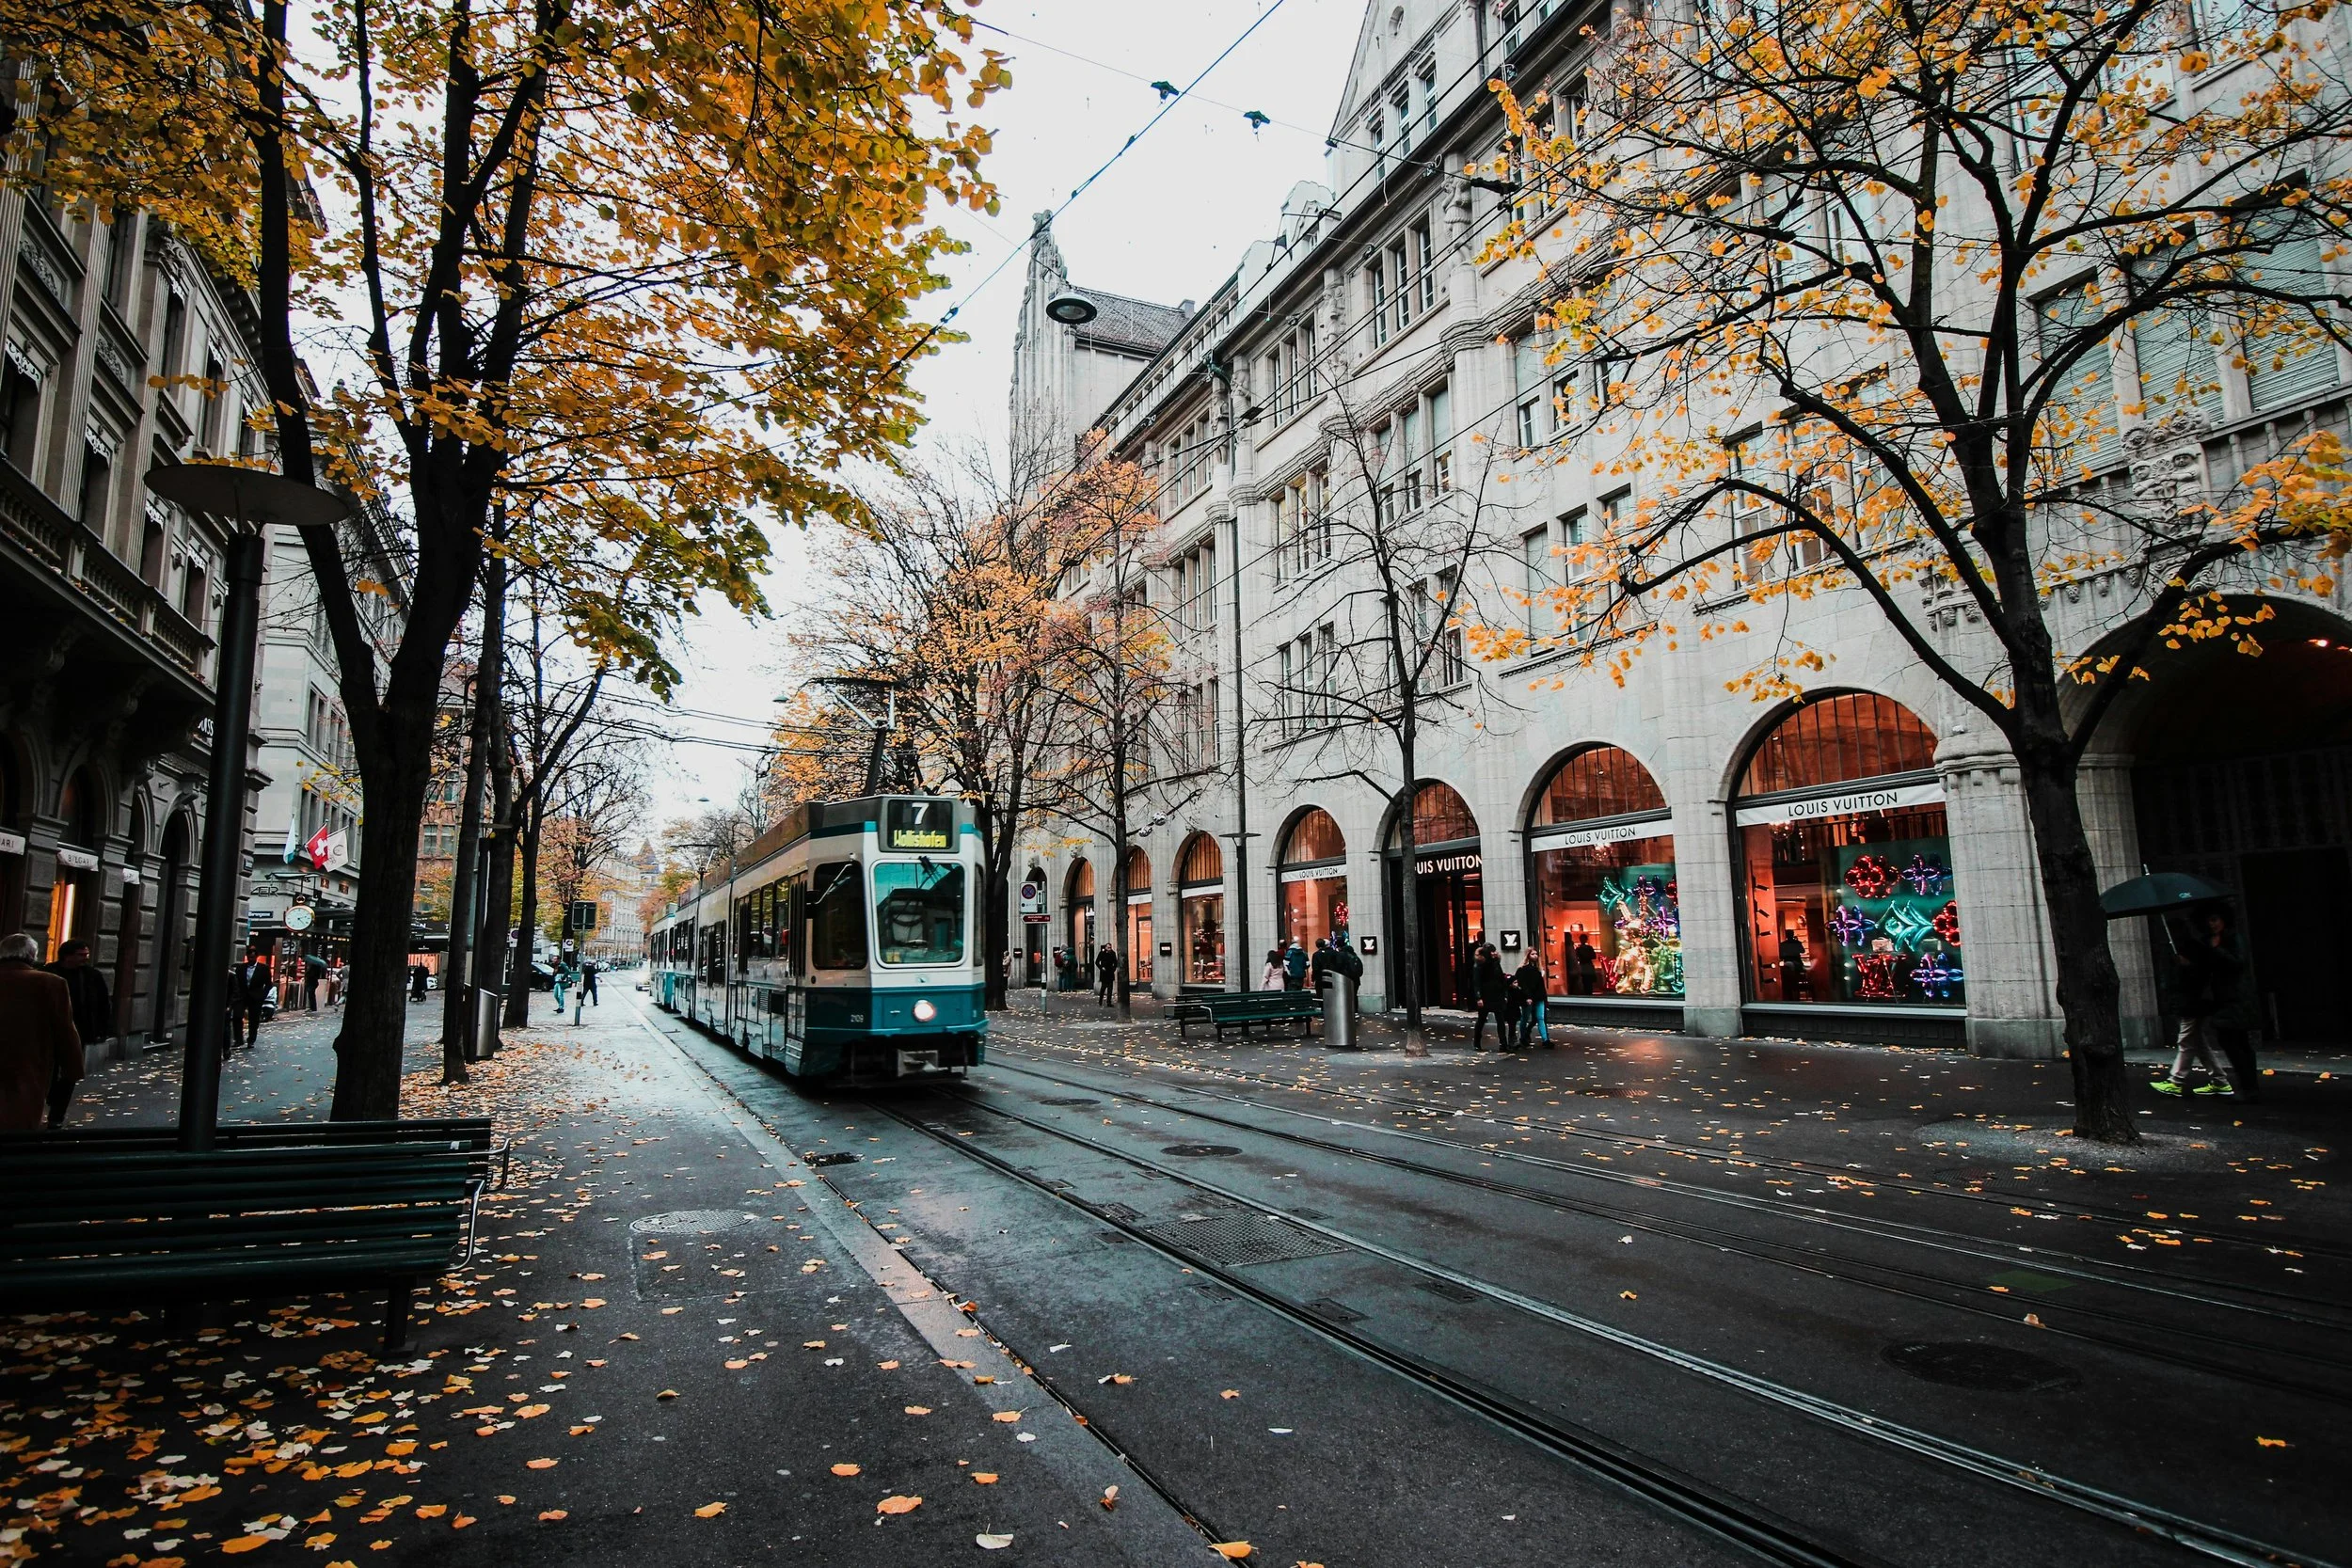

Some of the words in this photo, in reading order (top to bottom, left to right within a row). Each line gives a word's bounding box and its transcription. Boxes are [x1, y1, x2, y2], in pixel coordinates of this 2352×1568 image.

[912, 801, 930, 825] 7
[1788, 800, 1828, 817] LOUIS
[1834, 791, 1898, 810] VUITTON
[0, 838, 14, 848] ARI
[894, 830, 947, 847] Wollishofen
[1565, 832, 1592, 845] LOUIS
[1594, 827, 1636, 840] VUITTON
[1298, 870, 1314, 879] LOUIS
[1315, 867, 1338, 877] VUITTON
[1415, 860, 1434, 874] UIS
[1436, 854, 1483, 872] VUITTON
